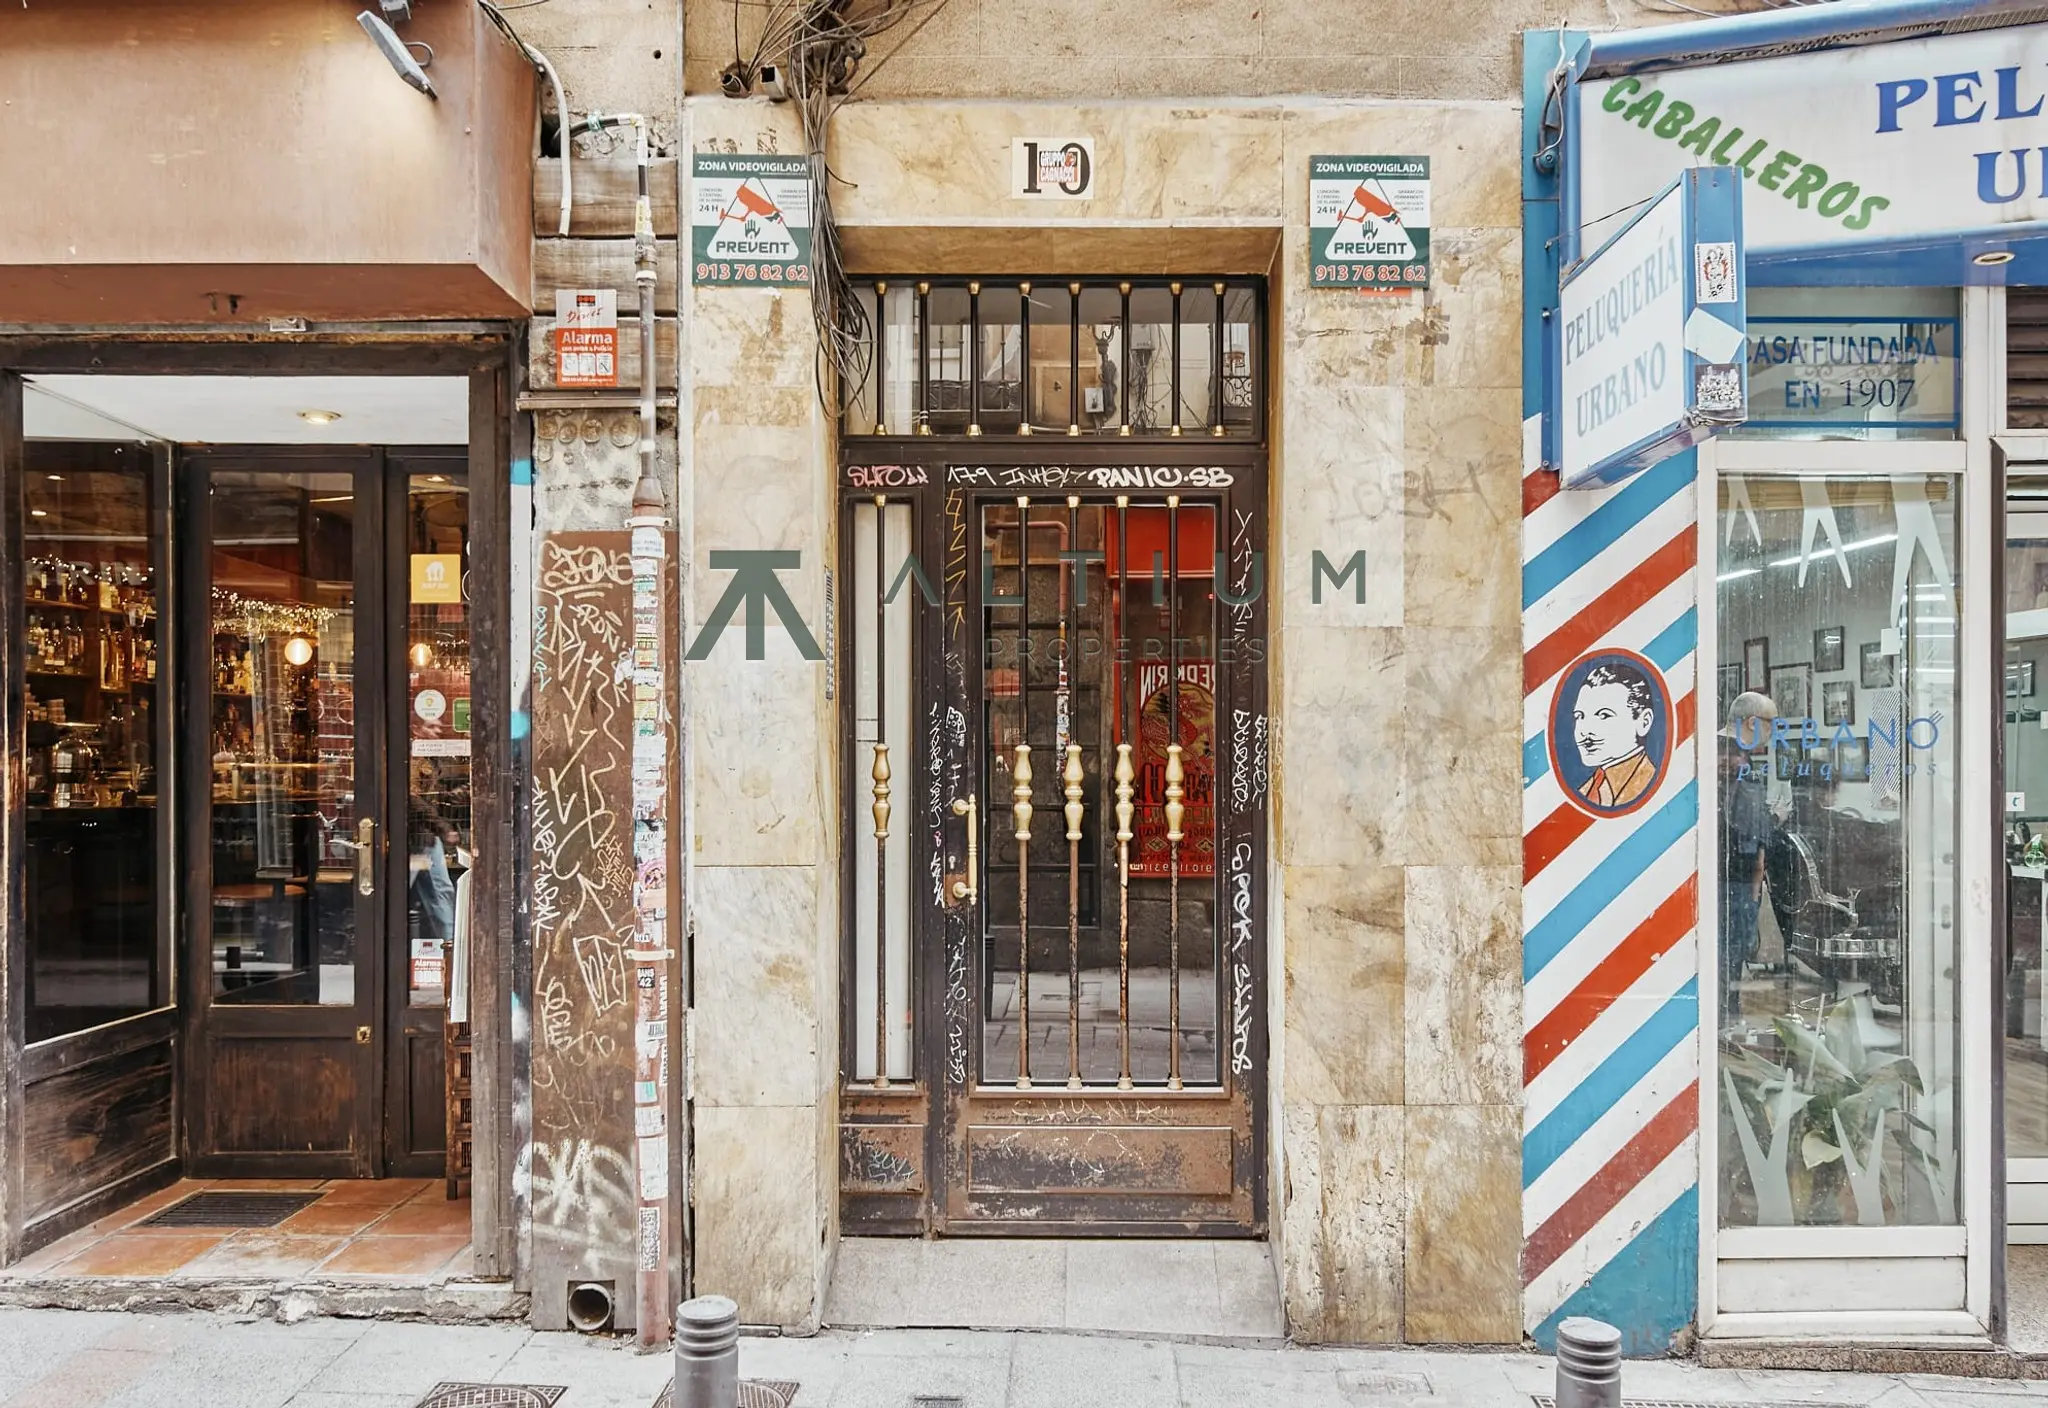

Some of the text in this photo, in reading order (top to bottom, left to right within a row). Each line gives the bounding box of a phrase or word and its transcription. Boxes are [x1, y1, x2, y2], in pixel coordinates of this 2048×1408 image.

[1875, 64, 2048, 133] PEL
[1602, 76, 1891, 230] CABALLEROS
[698, 161, 807, 172] ZONA VIDEOVIGILADA
[1023, 142, 1091, 195] 10
[1316, 163, 1424, 173] ZONA VIDEOVIGILADA
[698, 204, 710, 212] 24
[1316, 206, 1337, 214] 24 H
[716, 241, 790, 254] PREVENT
[1334, 242, 1408, 254] PREVENT
[696, 264, 809, 281] 913 76 82 62
[1315, 265, 1426, 281] 913 76 82 62
[1565, 226, 1679, 366] PELUQUERÍA
[562, 331, 613, 344] Alarma
[1746, 336, 1940, 364] ASA FUNDADA
[1576, 341, 1667, 438] URBANO
[1785, 378, 1916, 408] EN 1907
[1735, 713, 1941, 750] URBANO
[1737, 761, 1937, 782] peluqueros
